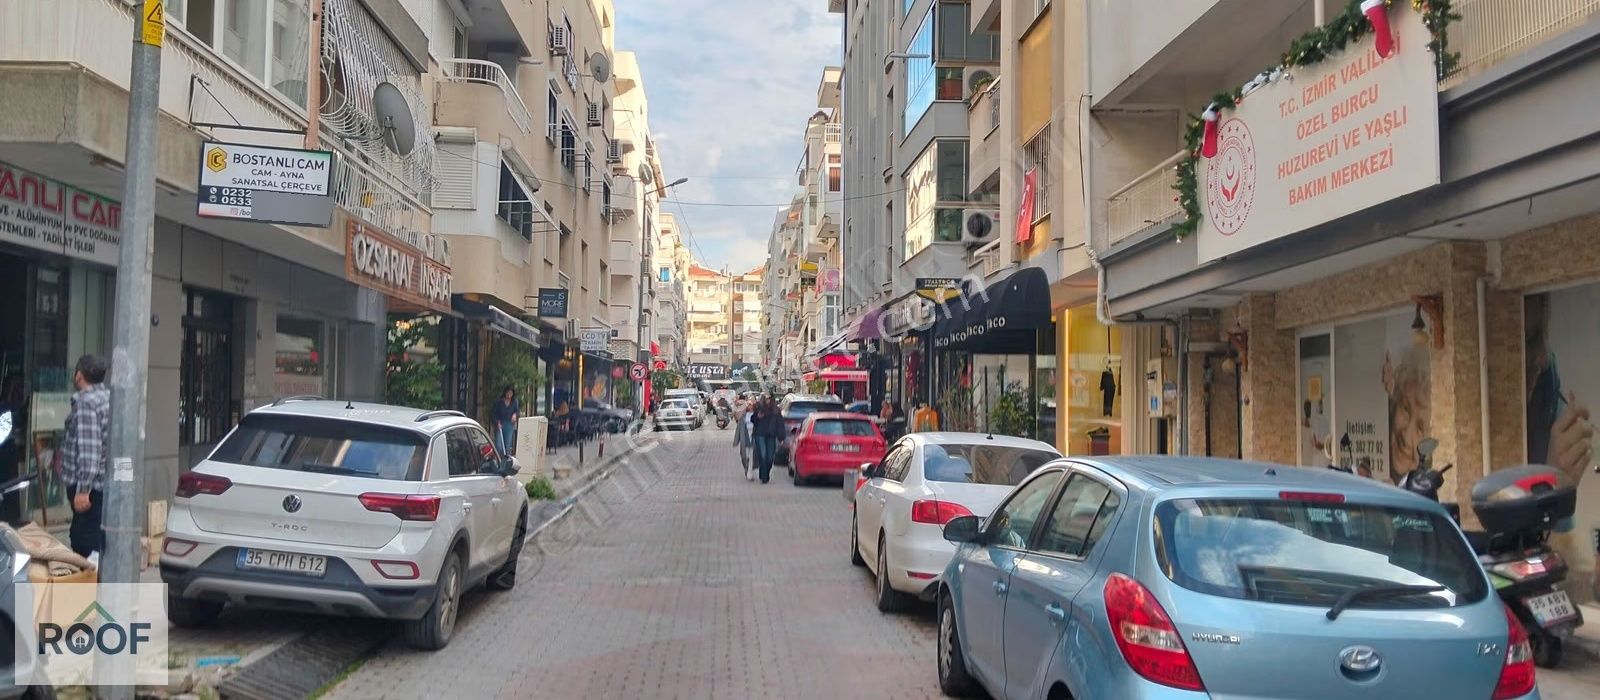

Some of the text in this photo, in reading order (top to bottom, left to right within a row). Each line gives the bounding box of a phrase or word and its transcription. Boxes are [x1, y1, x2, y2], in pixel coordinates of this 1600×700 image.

[1279, 30, 1401, 119] T.C. İZMİR VALİLİ
[1296, 84, 1380, 140] ÖZEL BURCU
[1277, 134, 1339, 180] HUZUREVİ
[1342, 127, 1361, 151] VE
[1364, 105, 1408, 139] YAŞLI
[233, 153, 324, 171] BOSTANLI CAM
[232, 177, 322, 192] SANATSAL ÇERÇEVE
[251, 168, 272, 177] CAM
[280, 171, 304, 180] AYNA
[1289, 174, 1328, 206] BAKIM
[1331, 142, 1394, 191] MERKEZİ
[221, 196, 251, 206] 0533
[222, 187, 251, 198] 0232
[16, 207, 62, 228] ALÜMİNYUM
[74, 224, 87, 237] PVC
[43, 230, 73, 249] TADİLAT
[74, 238, 95, 254] İŞLERİ
[352, 223, 415, 290] ÖZSARAY
[699, 366, 724, 375] USTA
[271, 522, 309, 532] T-ROC
[246, 550, 324, 571] 35 CPH 612
